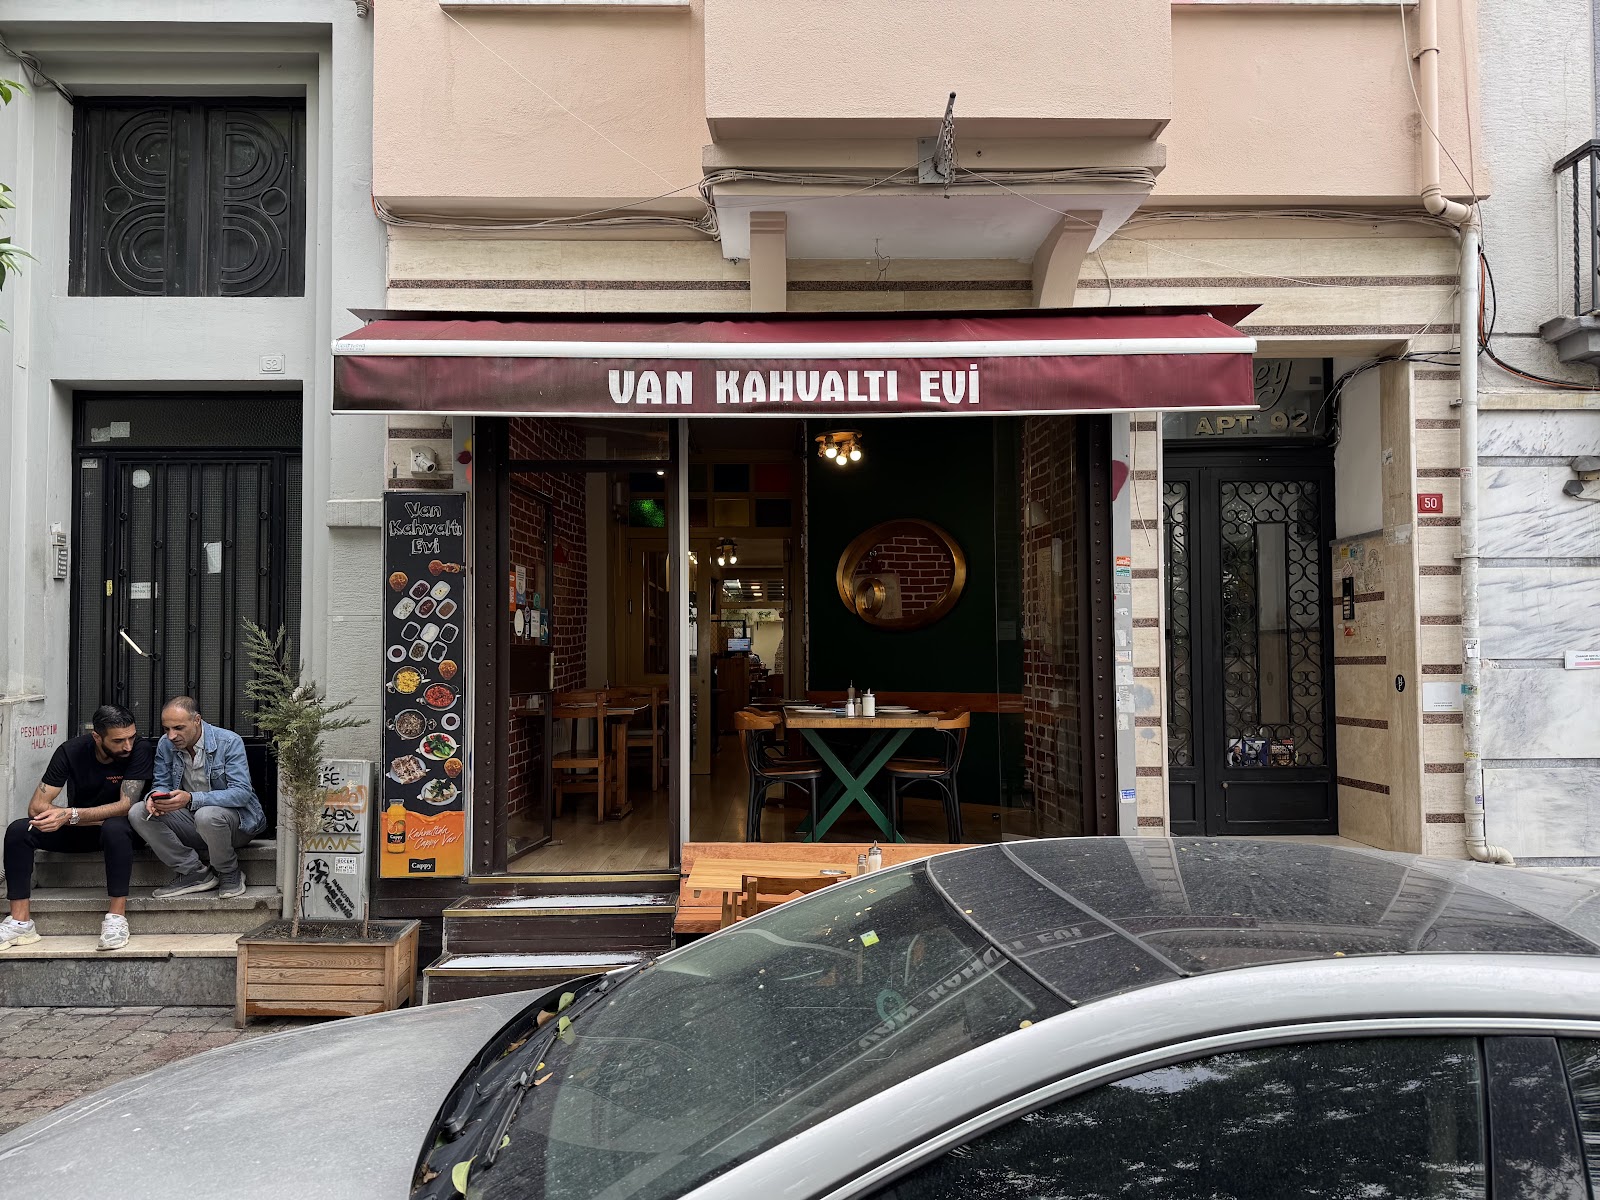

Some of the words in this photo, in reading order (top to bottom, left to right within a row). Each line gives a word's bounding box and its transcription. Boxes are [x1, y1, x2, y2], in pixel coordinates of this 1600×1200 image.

[608, 369, 693, 404] VAN
[716, 370, 898, 404] KAHVALTI
[919, 363, 979, 404] EVİ
[1270, 411, 1309, 433] 92
[404, 501, 442, 518] Van
[1424, 497, 1438, 509] 50
[411, 537, 441, 555] Evi
[414, 837, 440, 850] Cappy
[441, 832, 463, 846] Var!
[411, 862, 433, 870] Cappy
